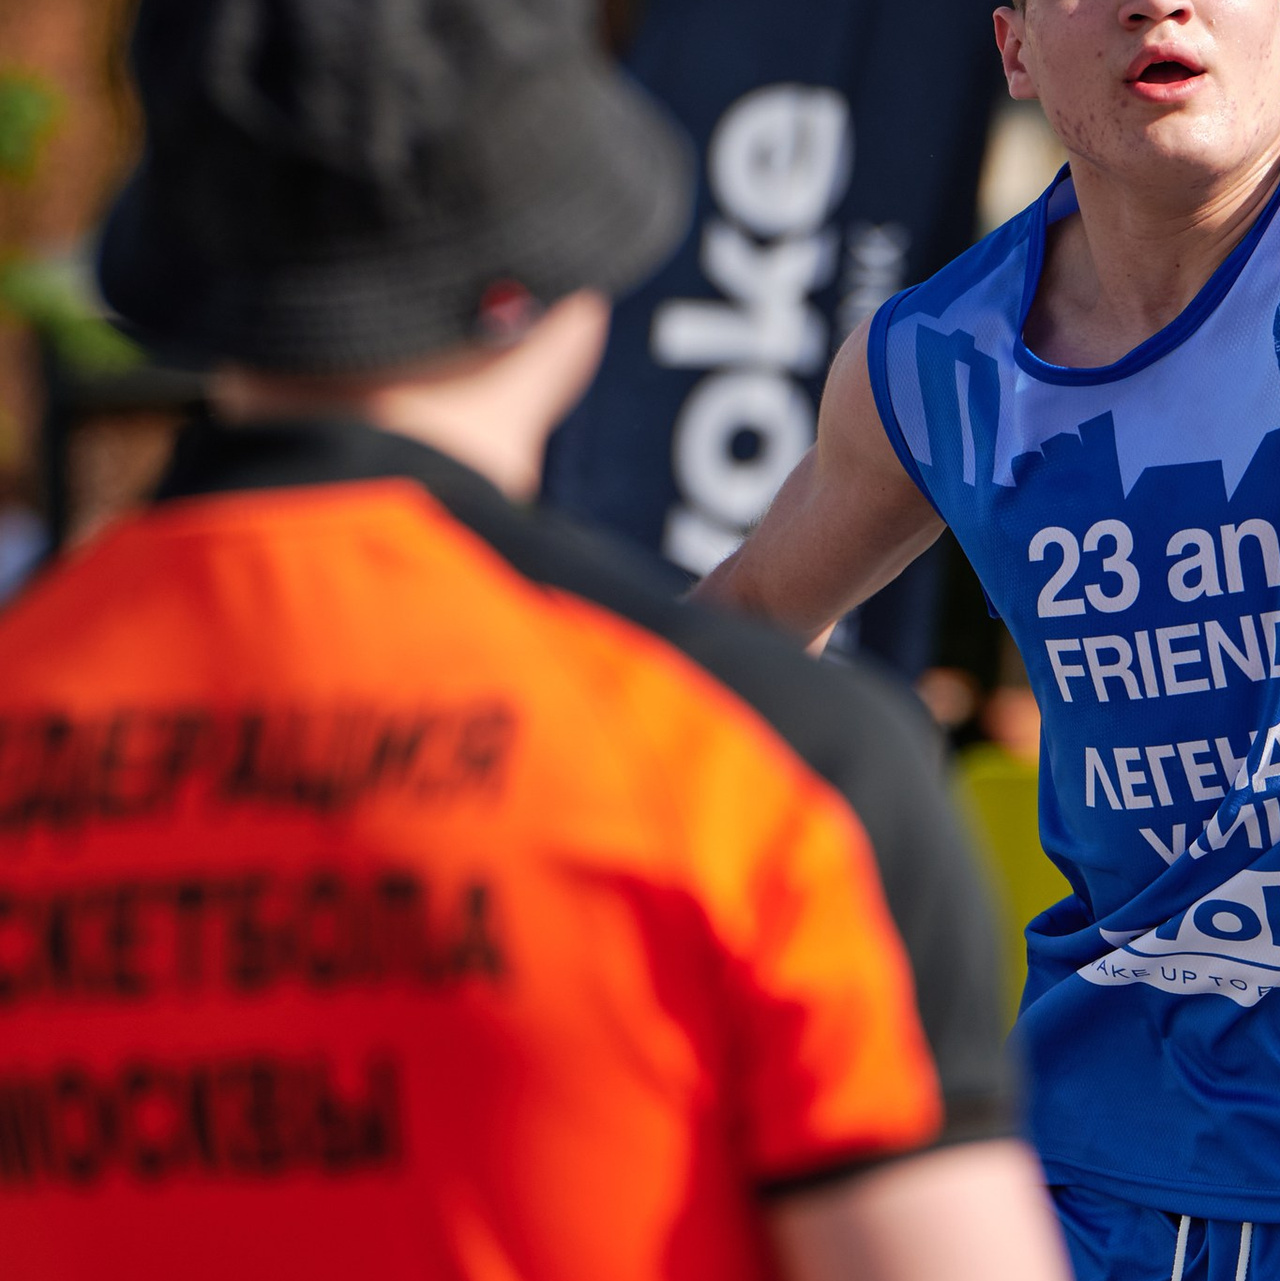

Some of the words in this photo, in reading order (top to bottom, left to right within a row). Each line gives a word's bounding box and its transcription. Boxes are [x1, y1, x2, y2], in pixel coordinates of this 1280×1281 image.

[652, 82, 850, 570] oke
[1028, 519, 1140, 618] 23
[1094, 959, 1150, 979] AKE
[1160, 966, 1198, 984] UP
[1208, 975, 1248, 992] TO
